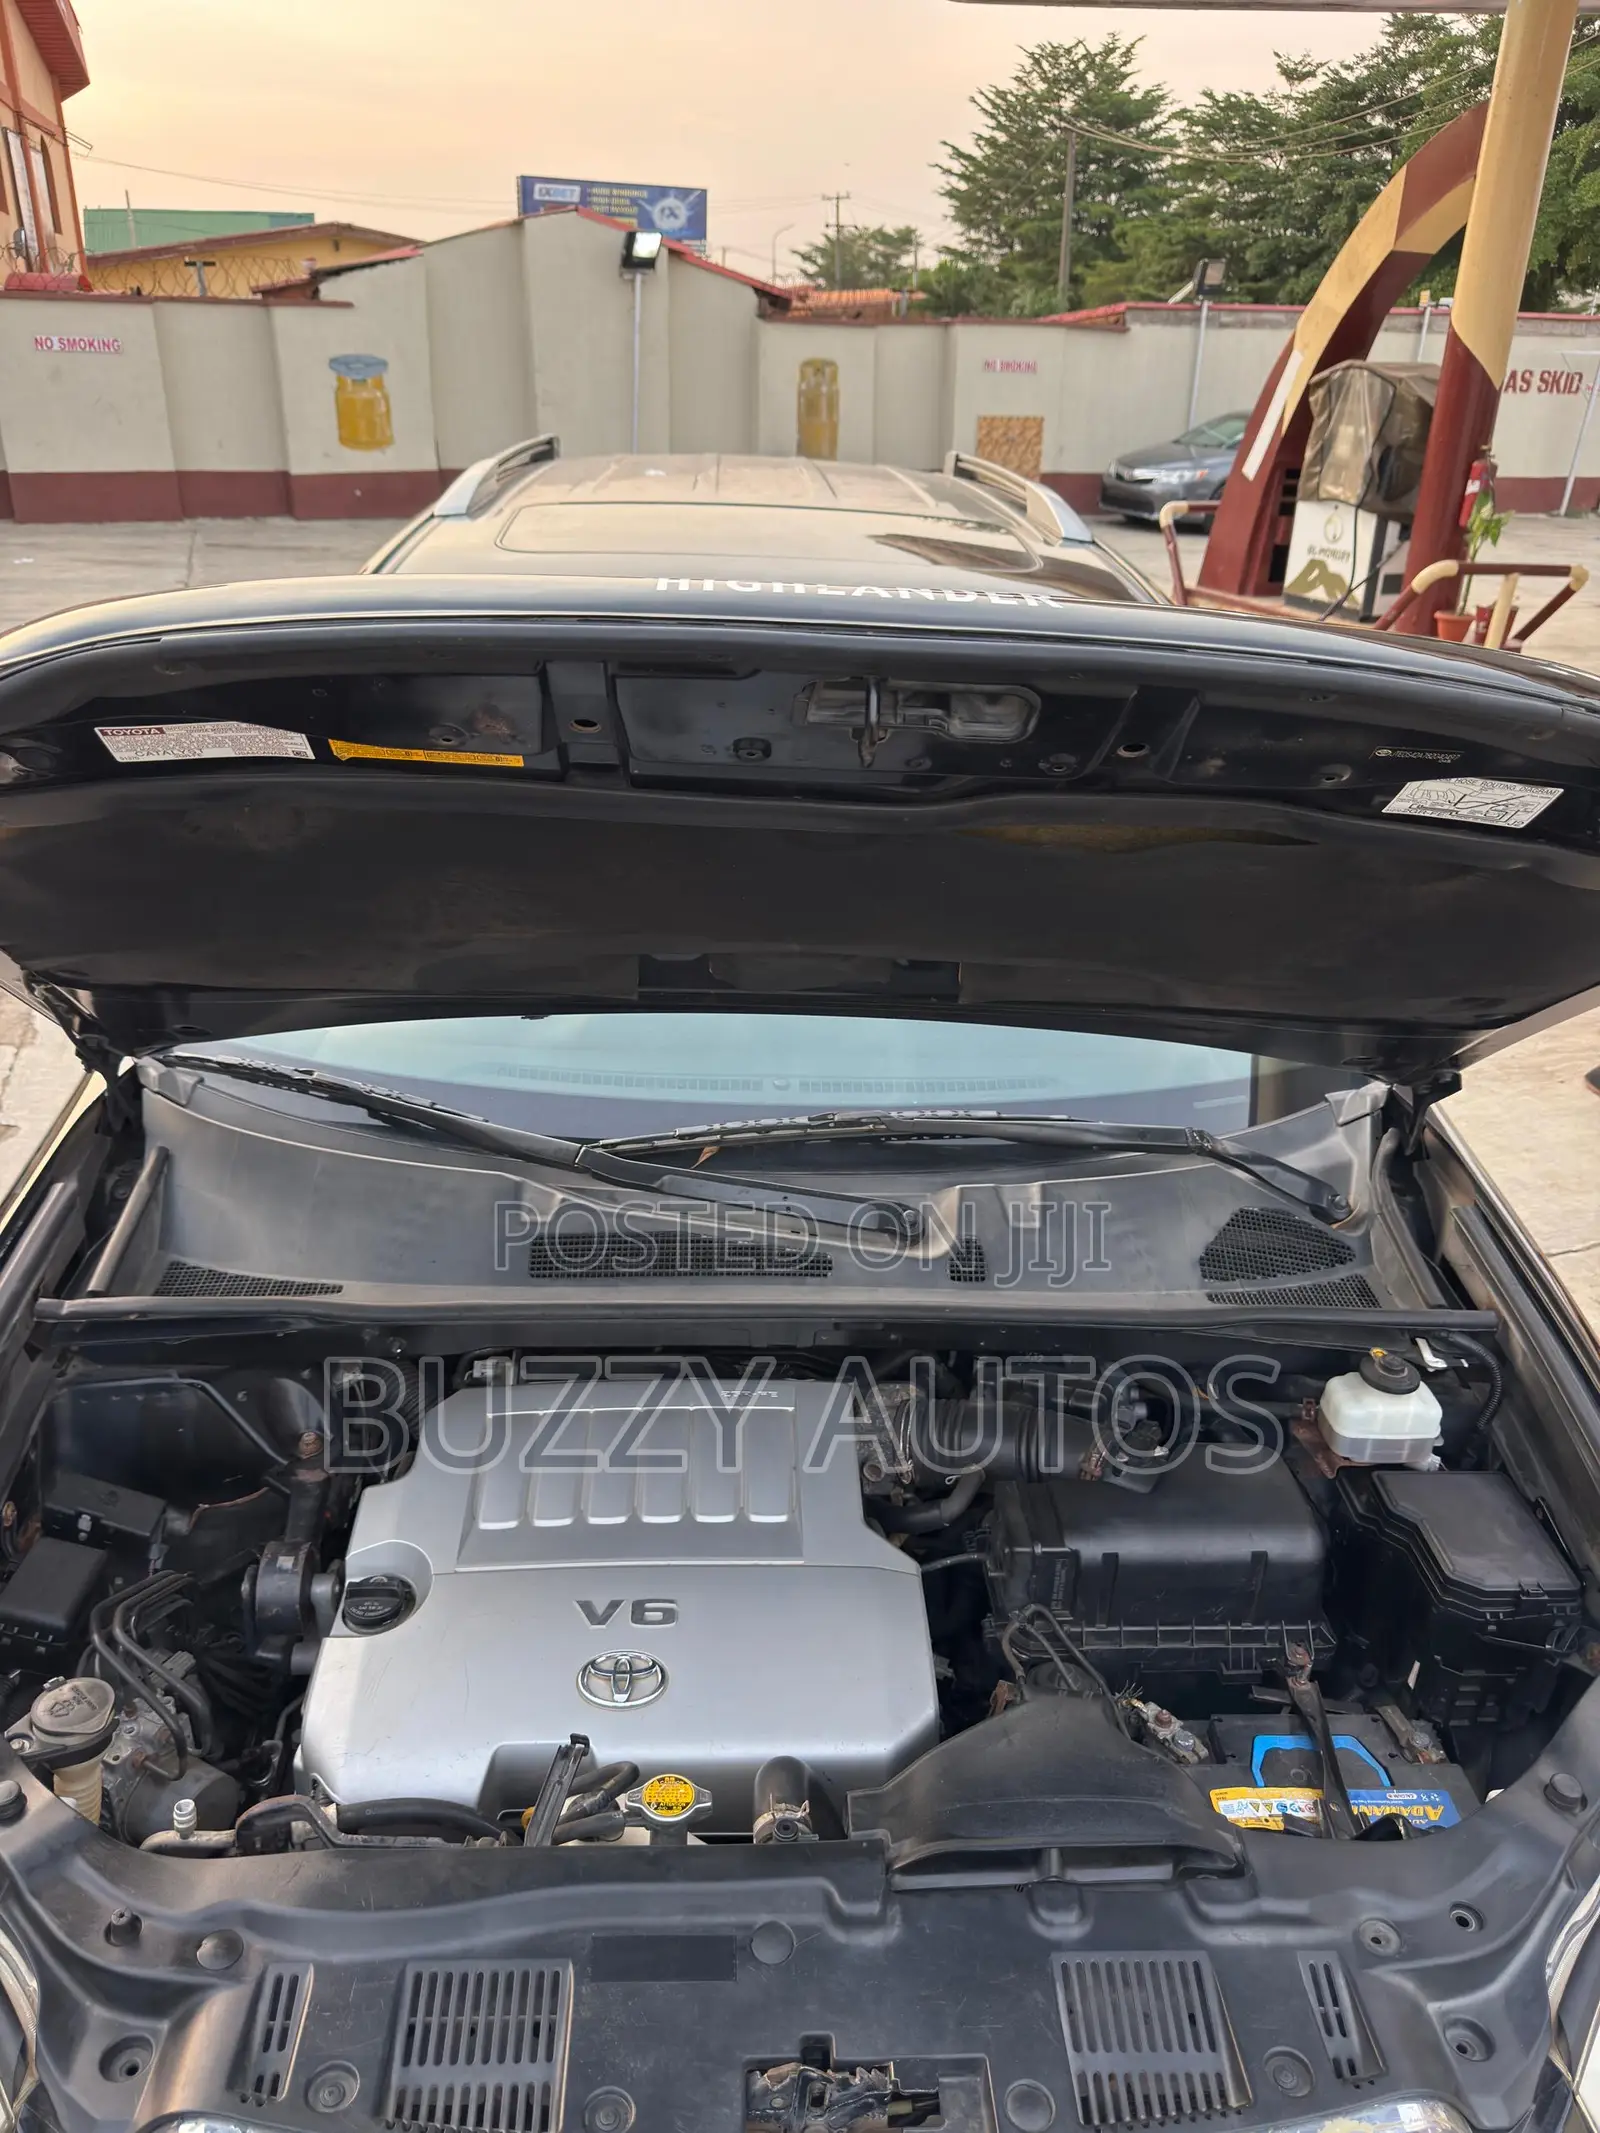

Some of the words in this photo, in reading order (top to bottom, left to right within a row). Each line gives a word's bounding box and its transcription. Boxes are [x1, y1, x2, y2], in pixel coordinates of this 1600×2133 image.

[34, 337, 54, 350] NO
[57, 338, 121, 352] SMOKING
[1537, 370, 1584, 395] SKID
[656, 577, 1064, 609] HIGHLANDER
[103, 728, 161, 736] TOYOTA
[1480, 781, 1517, 792] ROUTING
[1519, 786, 1560, 796] DIAGRAM
[573, 1599, 681, 1629] V6
